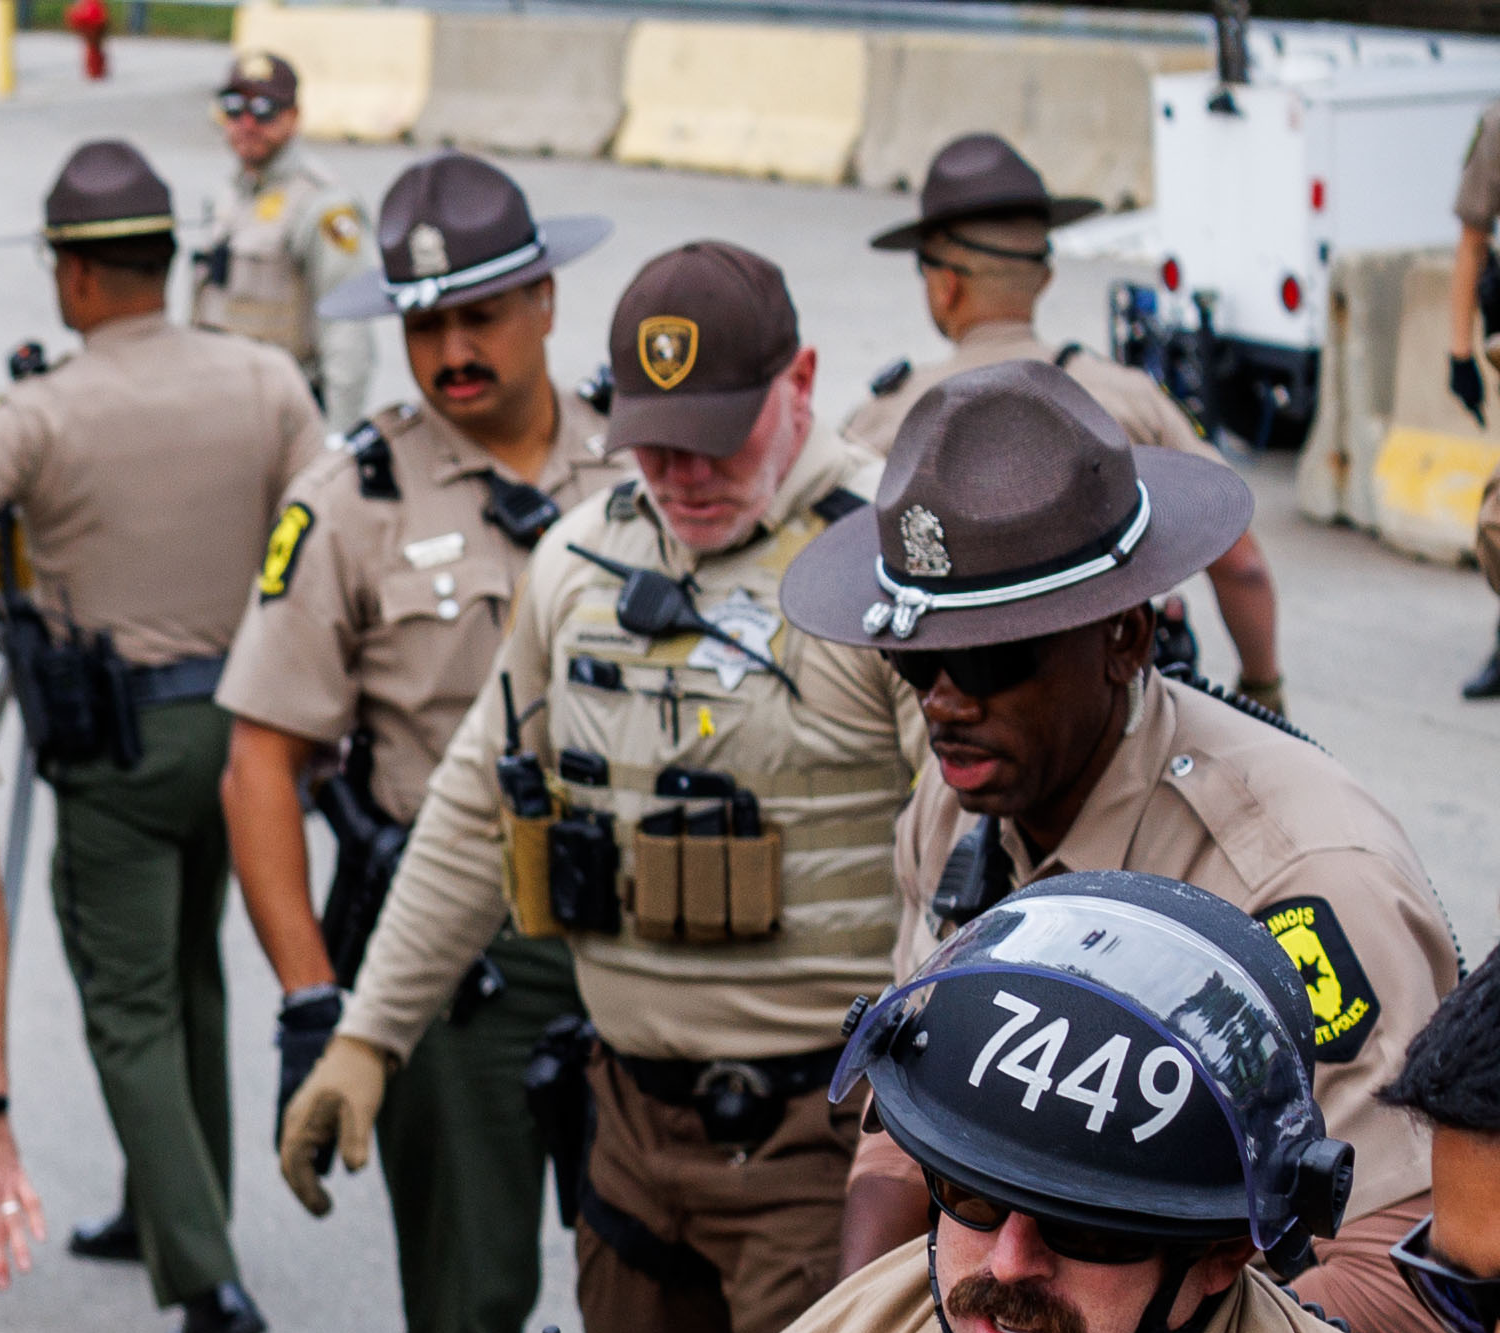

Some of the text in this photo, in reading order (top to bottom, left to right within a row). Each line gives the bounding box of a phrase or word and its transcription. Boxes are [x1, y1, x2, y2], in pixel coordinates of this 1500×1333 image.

[1268, 907, 1314, 936] INOIS
[1332, 997, 1370, 1038] POLICE
[969, 991, 1193, 1143] 7449
